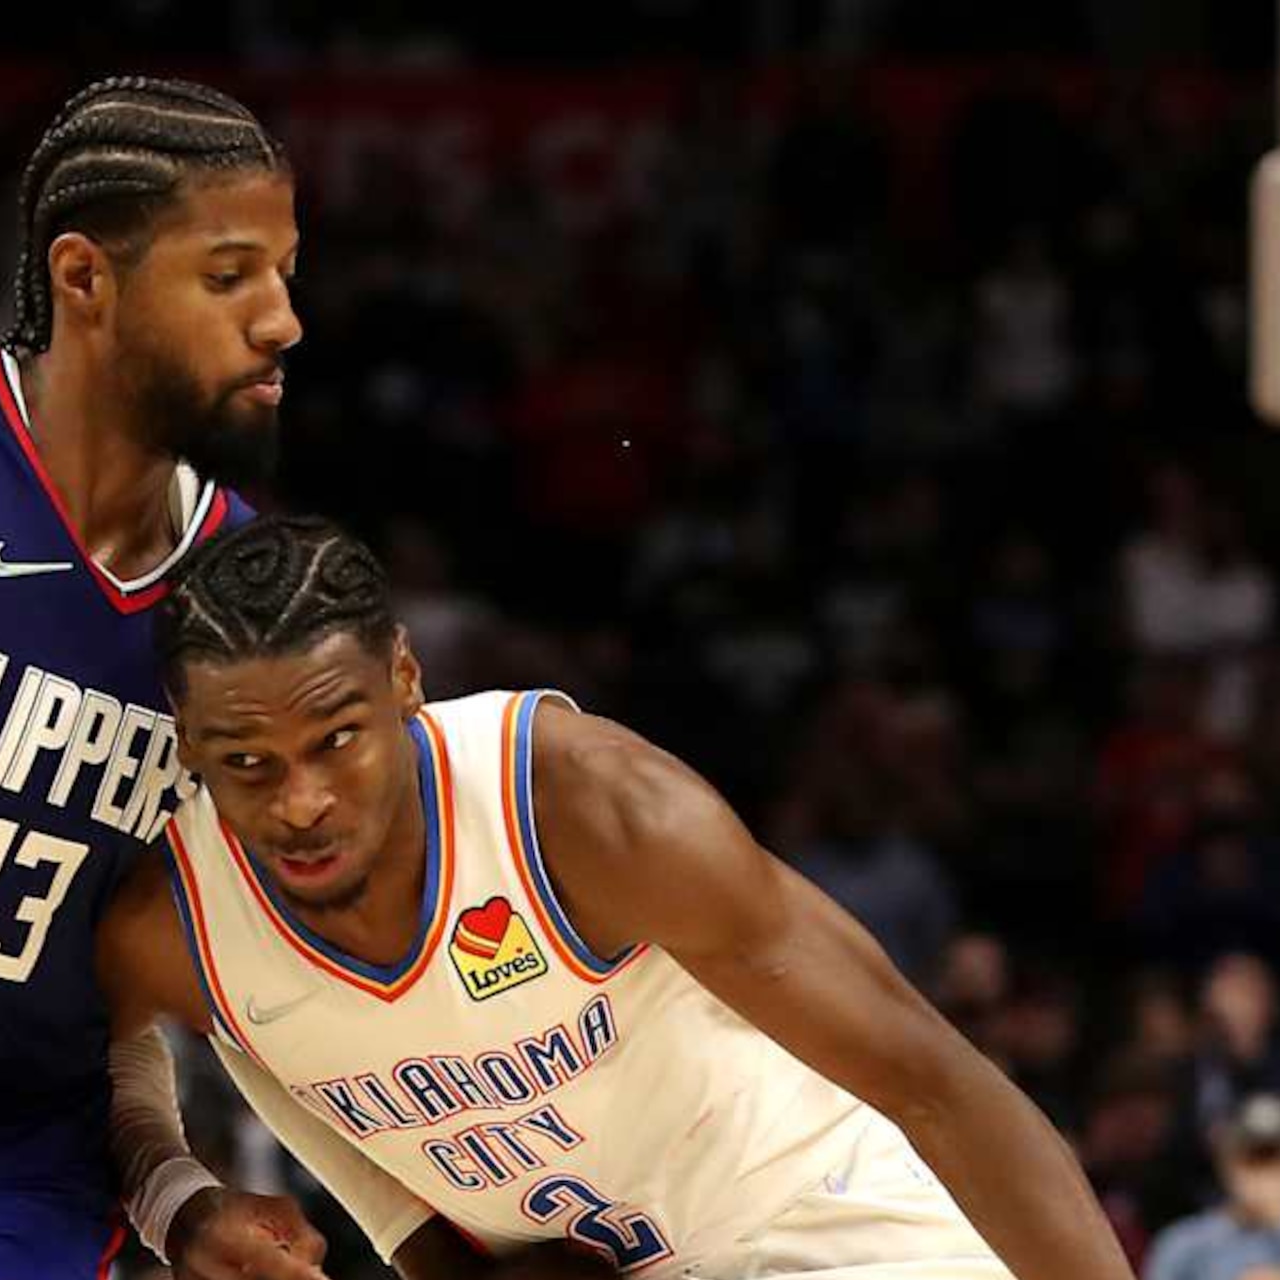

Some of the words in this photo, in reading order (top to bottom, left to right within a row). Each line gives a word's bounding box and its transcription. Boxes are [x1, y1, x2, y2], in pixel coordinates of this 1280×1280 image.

[291, 993, 618, 1139] KLAHOMA
[422, 1103, 585, 1191] CITY
[521, 1174, 673, 1271] 2
